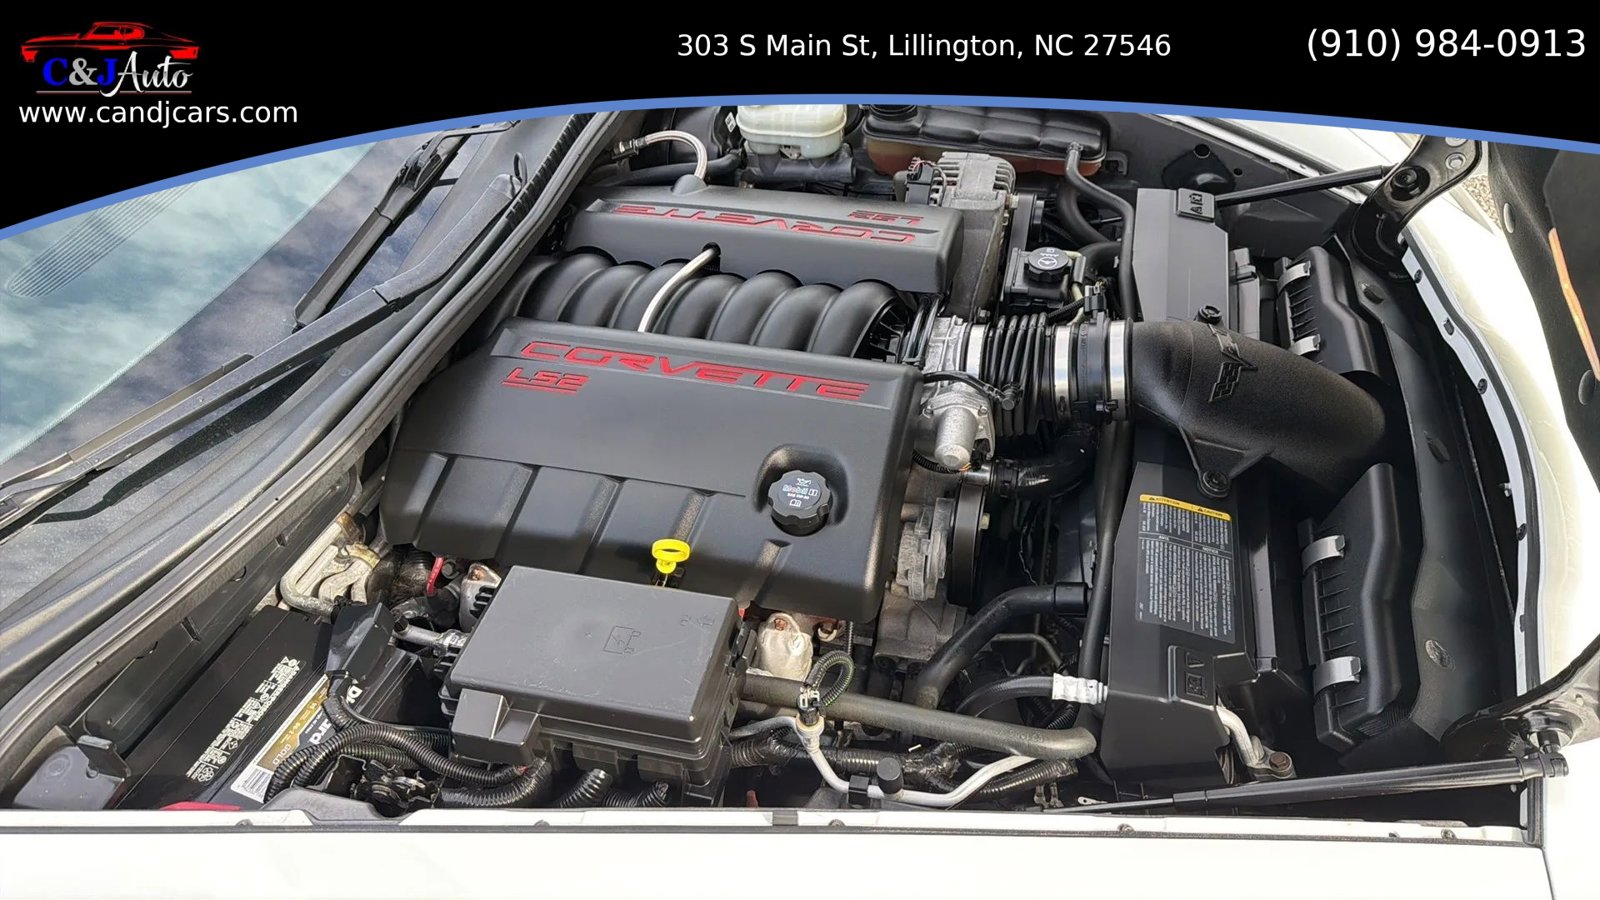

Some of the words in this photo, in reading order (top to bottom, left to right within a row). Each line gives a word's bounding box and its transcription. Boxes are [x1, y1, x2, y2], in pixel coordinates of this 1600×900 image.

[613, 205, 916, 243] CORVETTE
[848, 209, 925, 226] LS2
[502, 367, 589, 393] LS2
[520, 340, 870, 400] CORVETTE
[272, 743, 292, 765] GOLD
